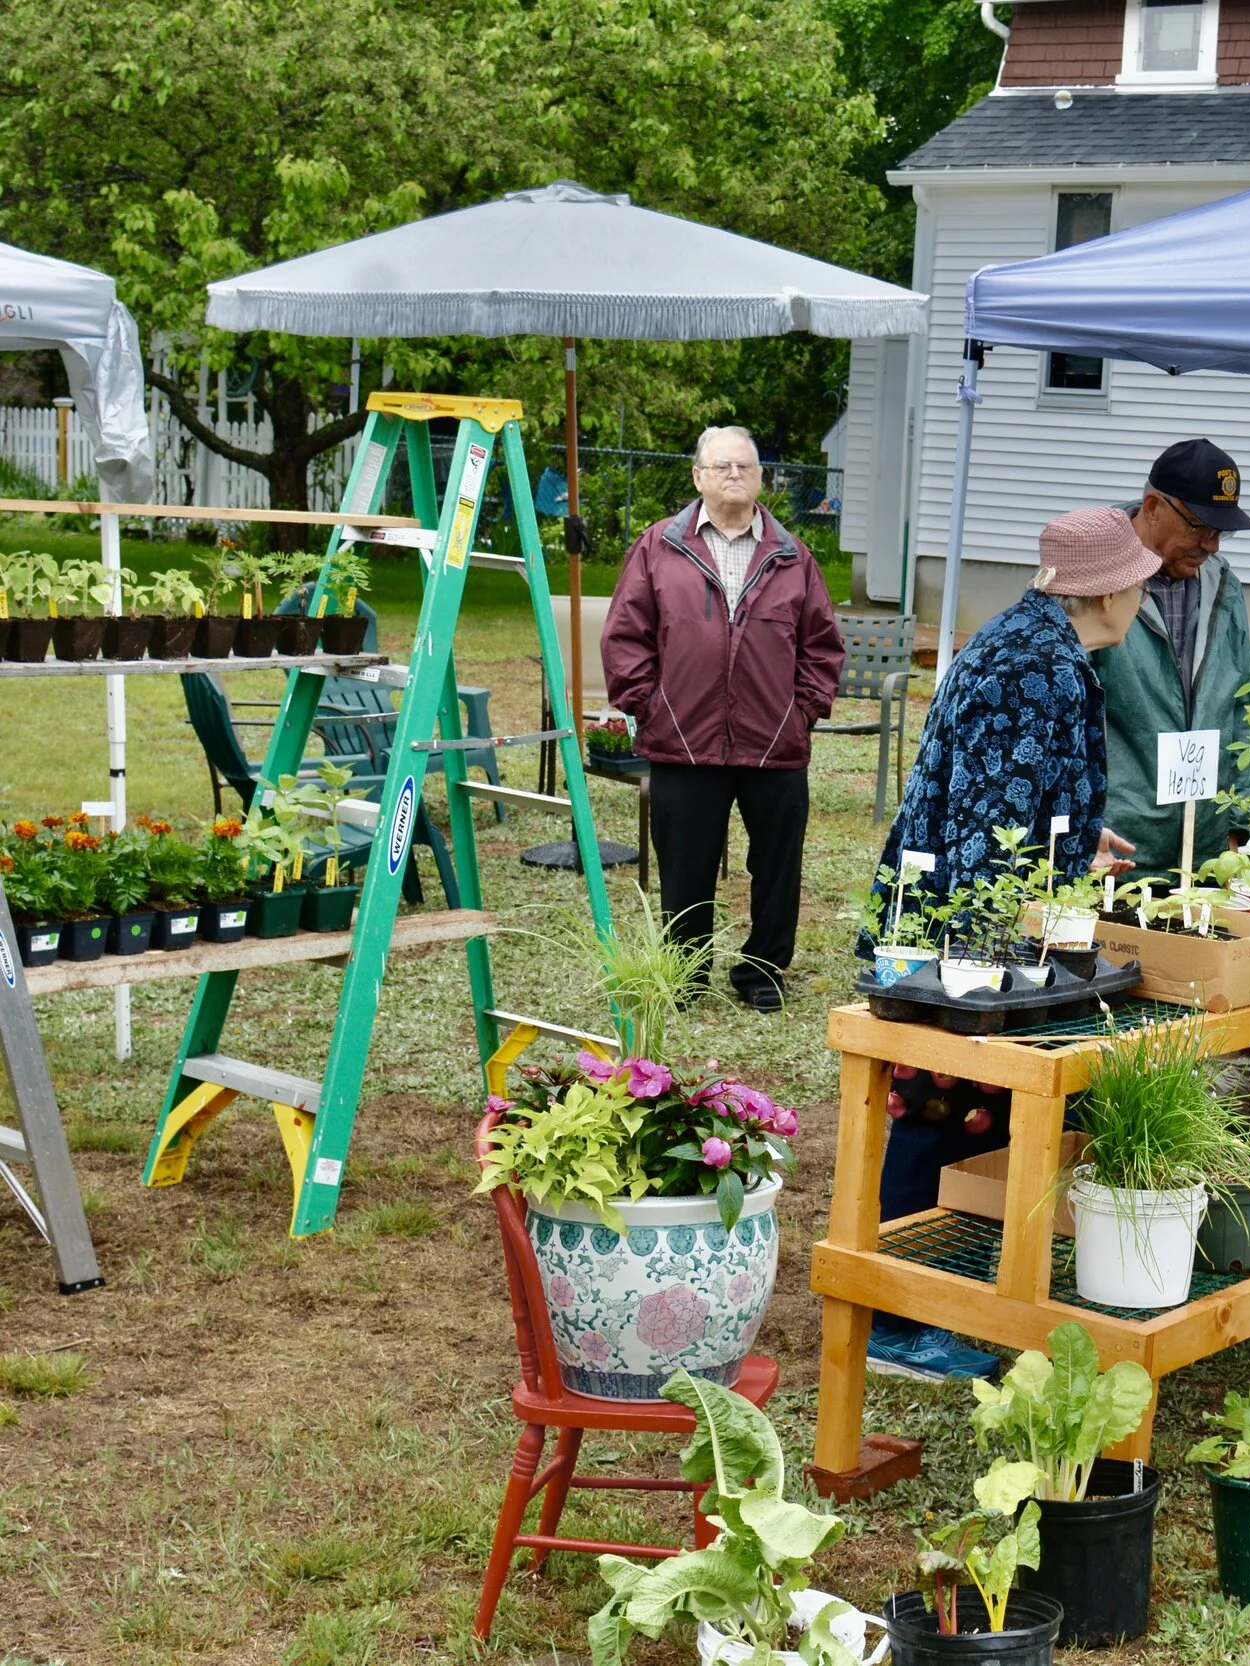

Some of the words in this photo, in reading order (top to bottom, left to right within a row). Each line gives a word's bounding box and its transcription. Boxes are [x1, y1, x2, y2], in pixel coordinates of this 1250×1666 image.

[0, 304, 33, 320] GLI
[1179, 738, 1205, 772] Veg
[1168, 768, 1206, 797] Herbs
[393, 796, 410, 854] WERNER
[1109, 940, 1140, 956] CLASSIC
